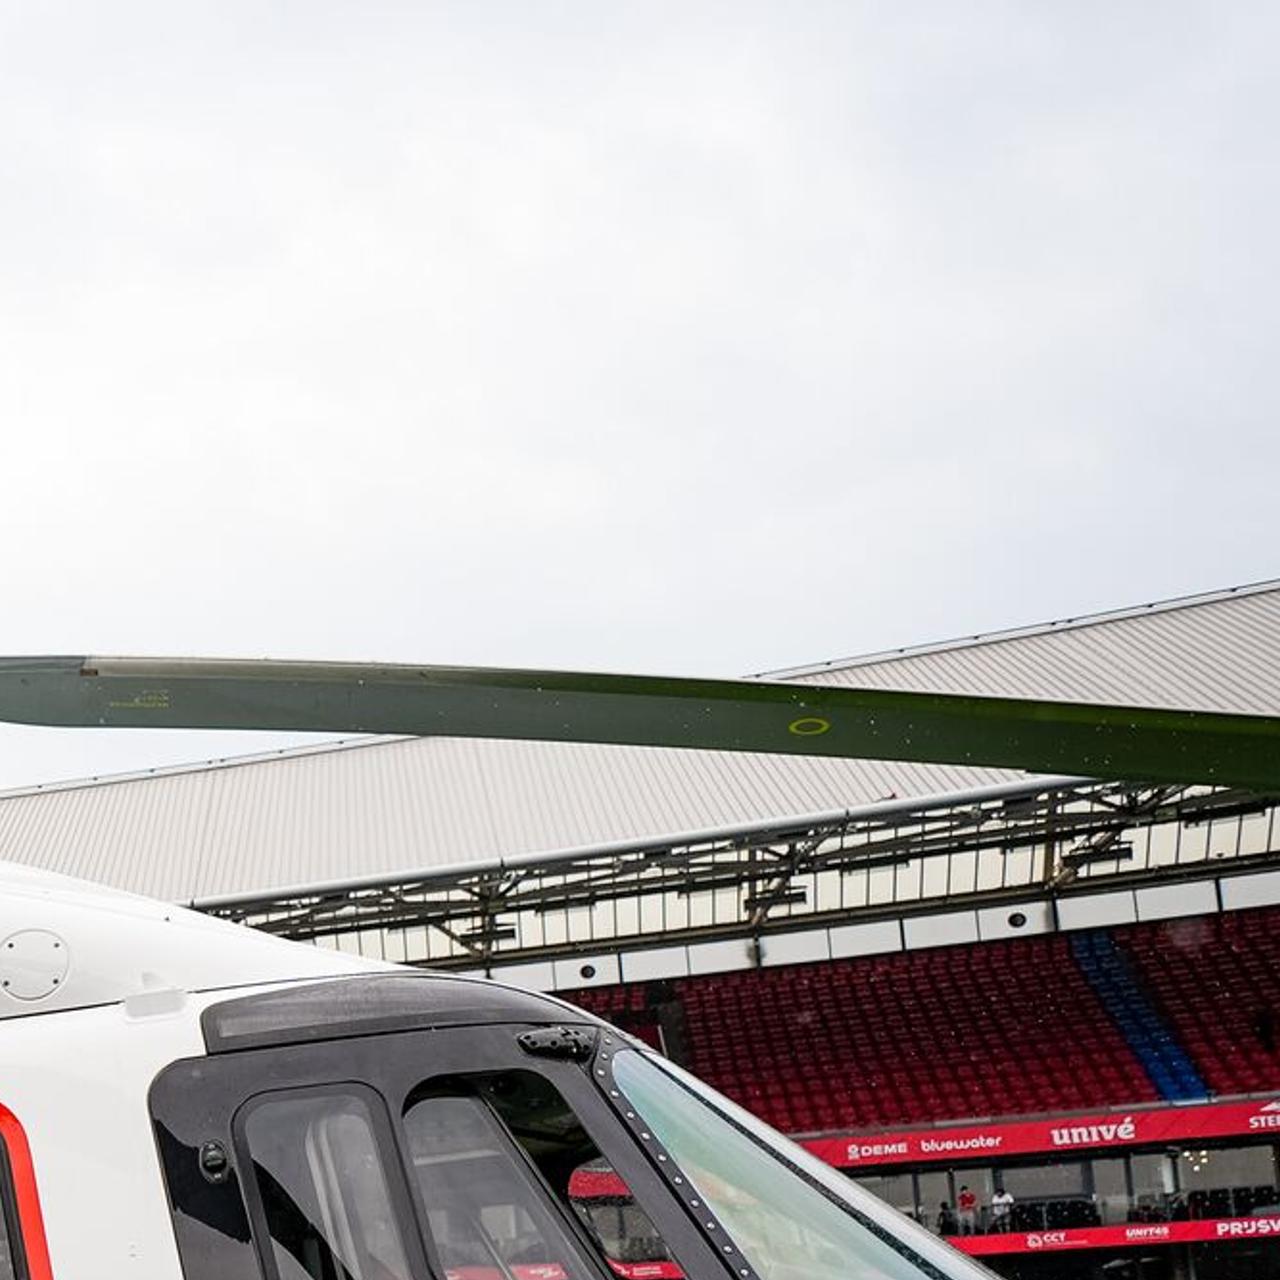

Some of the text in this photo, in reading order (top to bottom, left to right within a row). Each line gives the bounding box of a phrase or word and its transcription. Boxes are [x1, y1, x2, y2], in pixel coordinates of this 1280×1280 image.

[1051, 1116, 1136, 1145] univé
[861, 1136, 1002, 1157] DEME bluewater
